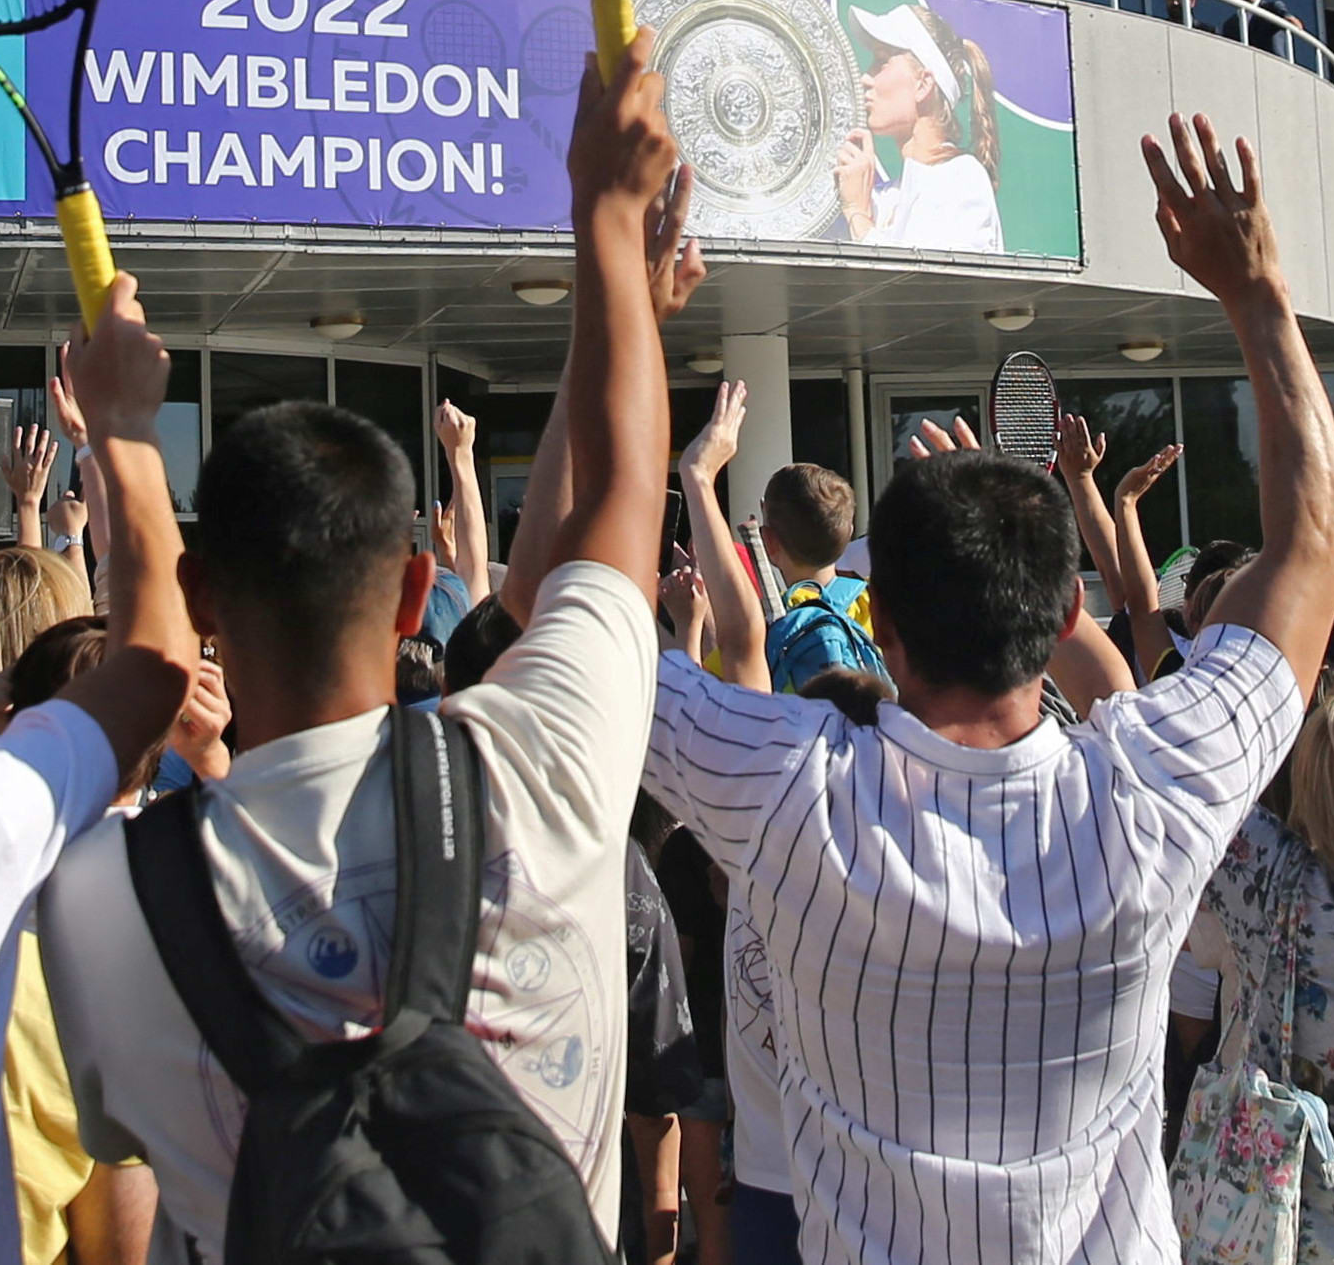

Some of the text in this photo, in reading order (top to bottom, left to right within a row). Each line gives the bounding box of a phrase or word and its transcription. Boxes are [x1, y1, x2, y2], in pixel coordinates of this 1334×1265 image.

[83, 48, 519, 120] WIMBLEDON
[103, 127, 503, 195] CHAMPION!
[437, 750, 449, 776] FEAR
[440, 776, 452, 806] YOUR
[442, 807, 454, 837] OVER
[444, 838, 455, 860] GET
